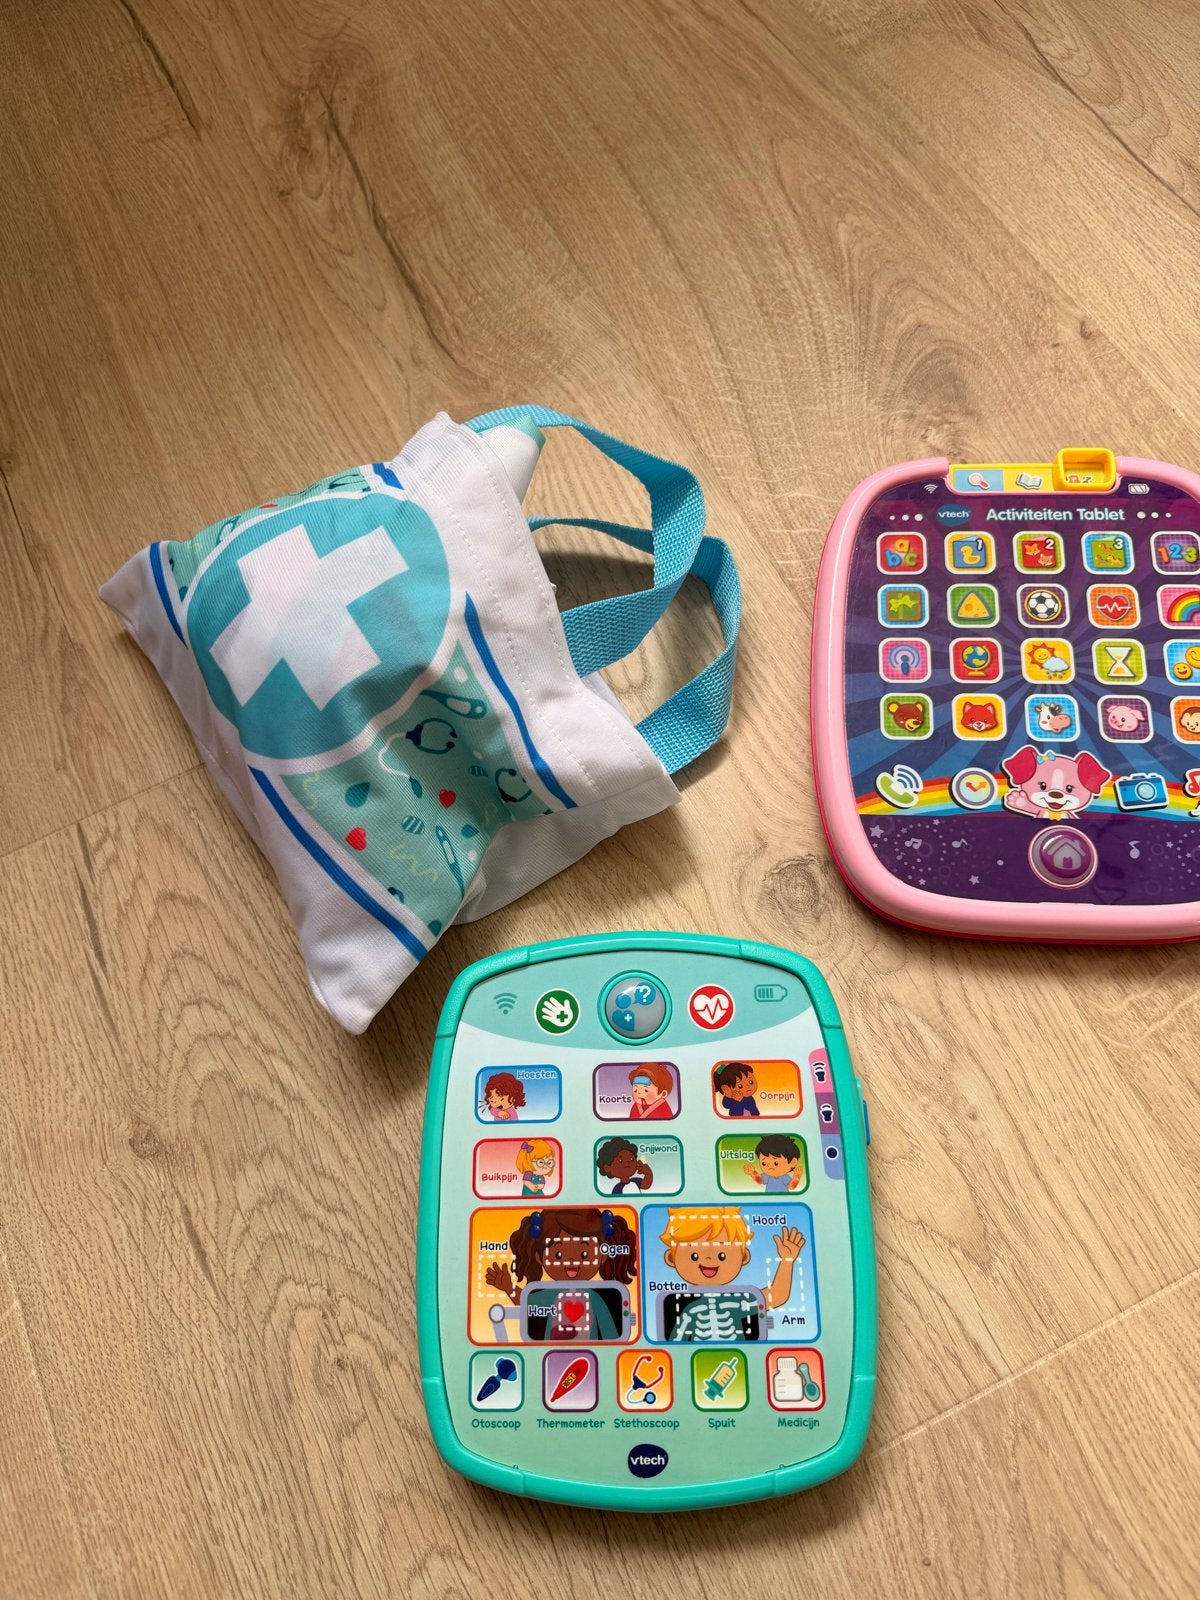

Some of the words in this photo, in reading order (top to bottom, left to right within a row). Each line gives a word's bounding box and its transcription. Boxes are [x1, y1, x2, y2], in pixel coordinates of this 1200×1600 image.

[937, 510, 970, 518] vtech
[986, 508, 1073, 521] Activiteiten
[1077, 508, 1125, 521] Tablet
[976, 538, 983, 551] 1
[1045, 538, 1055, 550] 2
[1114, 538, 1124, 550] 3
[517, 1070, 557, 1079] Hoesten
[599, 1095, 632, 1103] Koorts
[760, 1092, 795, 1101] Oorpijn
[639, 1144, 678, 1155] Snijwond
[720, 1150, 755, 1161] Uitslag
[481, 1173, 518, 1183] Buikpijn
[753, 1215, 787, 1225] Hoofd
[480, 1241, 508, 1251] Hand
[600, 1243, 630, 1256] Ogen
[649, 1281, 688, 1291] Botten
[528, 1305, 557, 1317] Hart
[782, 1315, 805, 1325] Arm
[471, 1418, 521, 1431] Otoscoop
[536, 1418, 606, 1430] Thermometer
[613, 1418, 680, 1431] Stethoscoop
[708, 1418, 736, 1430] Spuit
[777, 1417, 820, 1430] Medicijn
[630, 1454, 665, 1465] vtech
